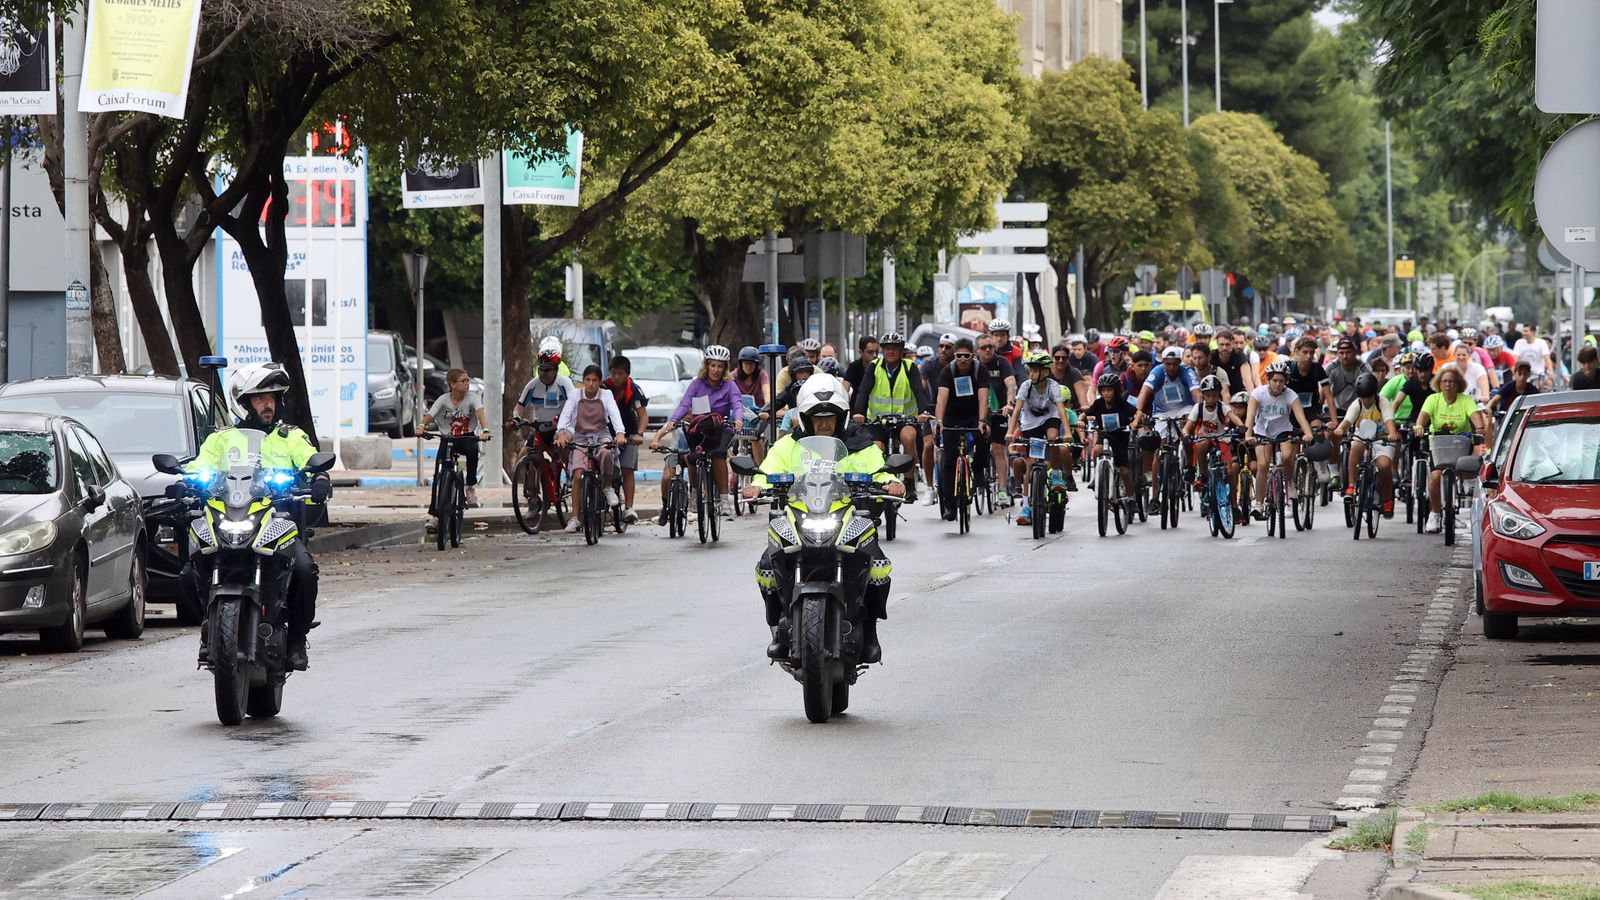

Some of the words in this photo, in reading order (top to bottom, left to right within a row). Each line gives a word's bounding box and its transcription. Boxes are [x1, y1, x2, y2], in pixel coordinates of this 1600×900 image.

[20, 97, 43, 105] Caixa"
[98, 92, 166, 109] CaixaForum
[512, 190, 565, 201] CaixaForum
[10, 203, 42, 218] sta
